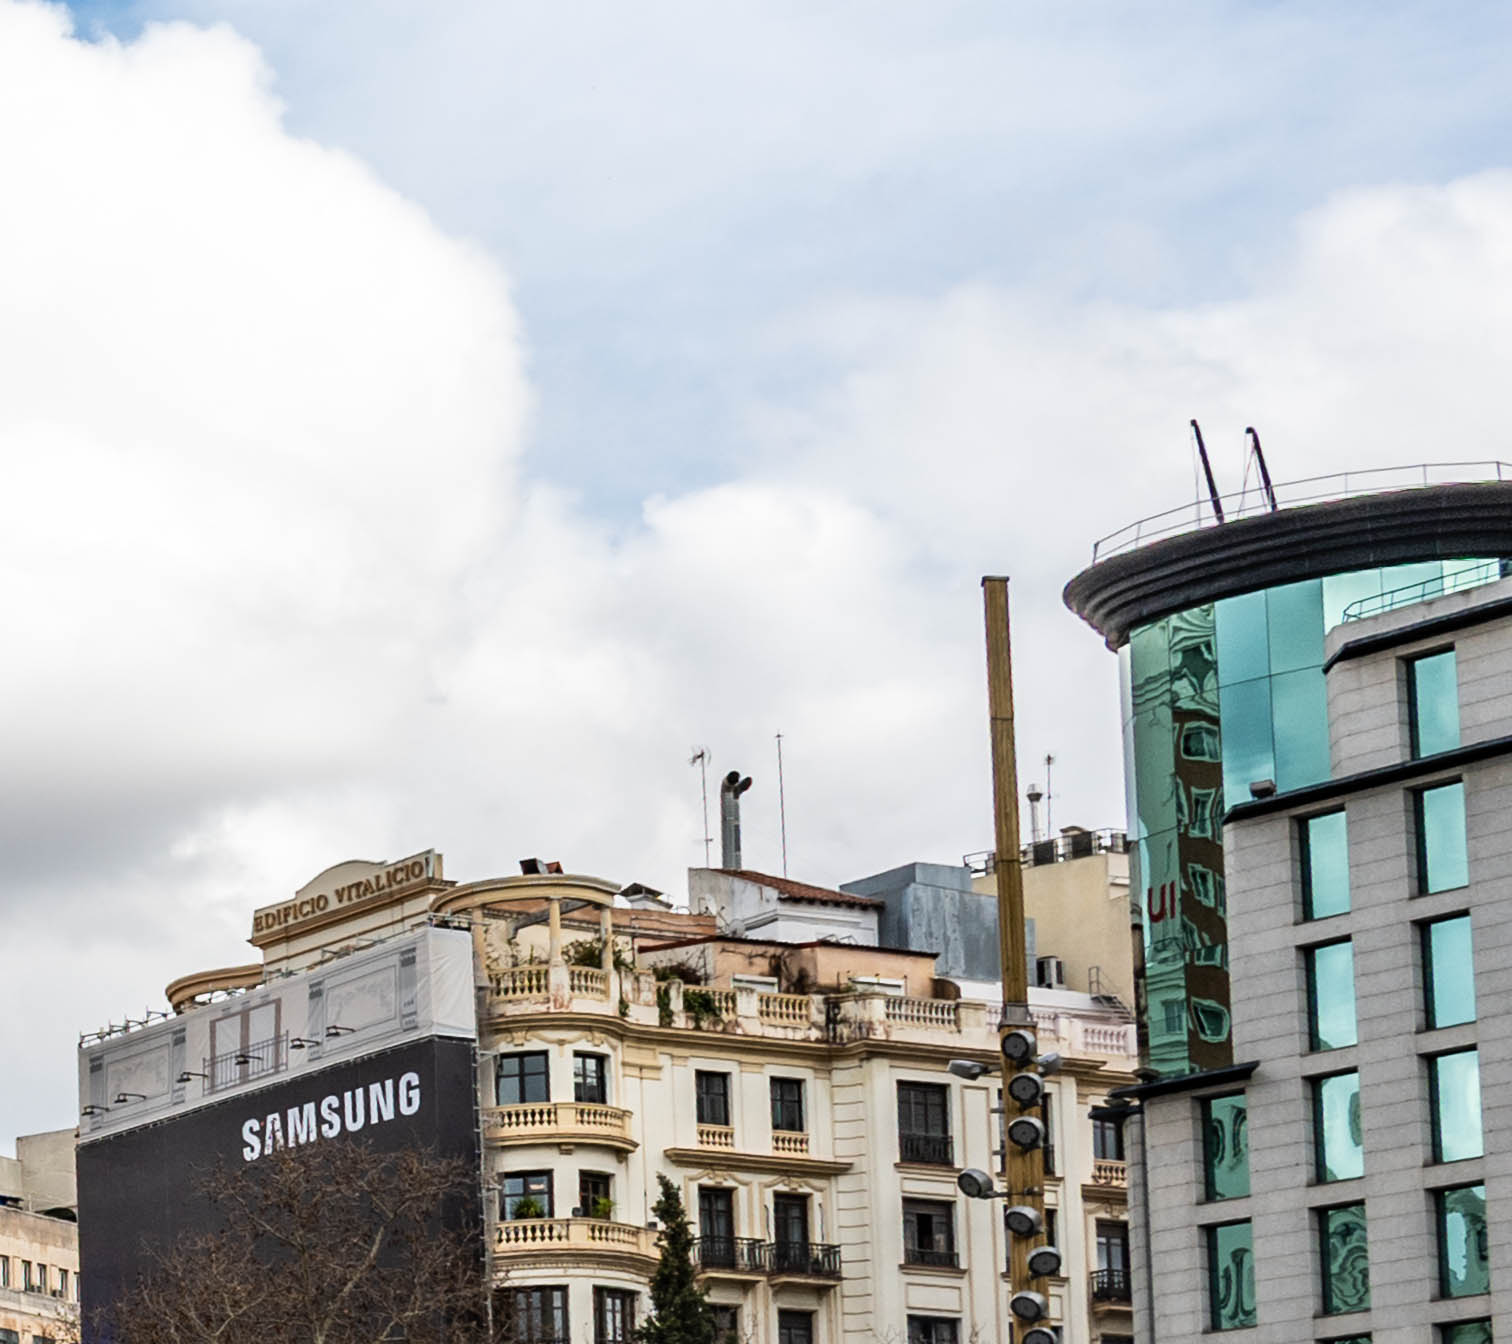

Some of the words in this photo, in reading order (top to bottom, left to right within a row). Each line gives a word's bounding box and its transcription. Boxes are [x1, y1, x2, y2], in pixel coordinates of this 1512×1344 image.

[254, 894, 329, 933] EDIFICIO
[335, 860, 425, 905] VITALICIO
[241, 1071, 421, 1162] SAMSUNG
